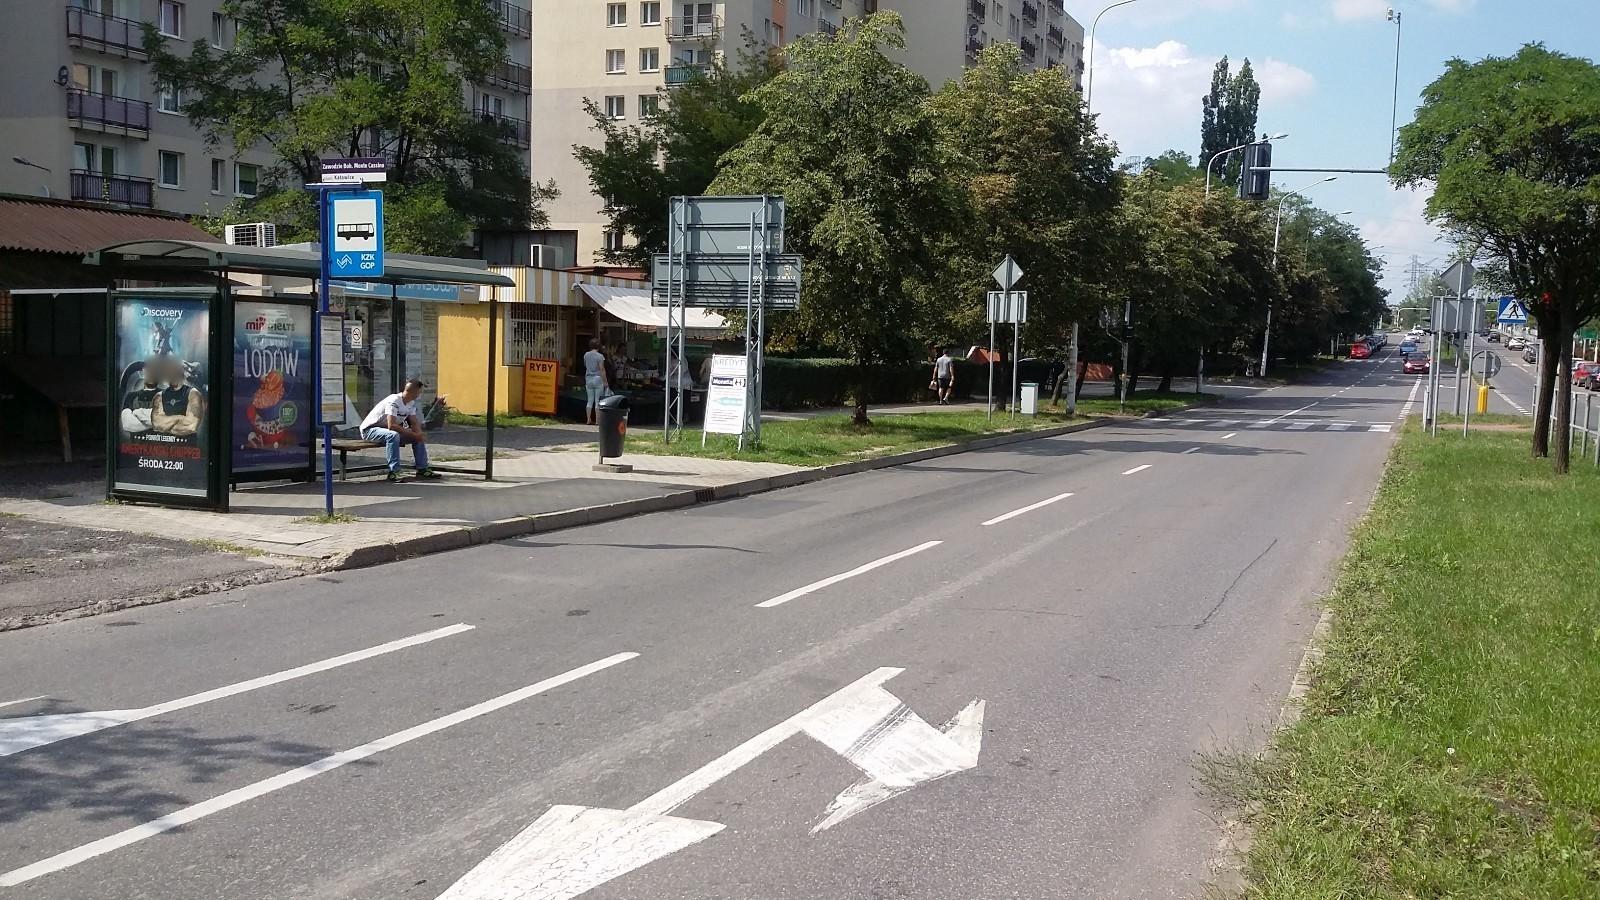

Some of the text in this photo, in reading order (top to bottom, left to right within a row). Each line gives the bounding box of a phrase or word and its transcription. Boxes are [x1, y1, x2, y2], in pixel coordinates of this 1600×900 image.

[322, 162, 342, 170] Zawodzie
[368, 161, 385, 169] Cassino
[361, 253, 375, 261] KZK
[360, 262, 375, 270] GOP
[142, 307, 183, 318] Discovery
[529, 362, 554, 373] RYBY
[138, 456, 184, 471] ŚRODA 22:00
